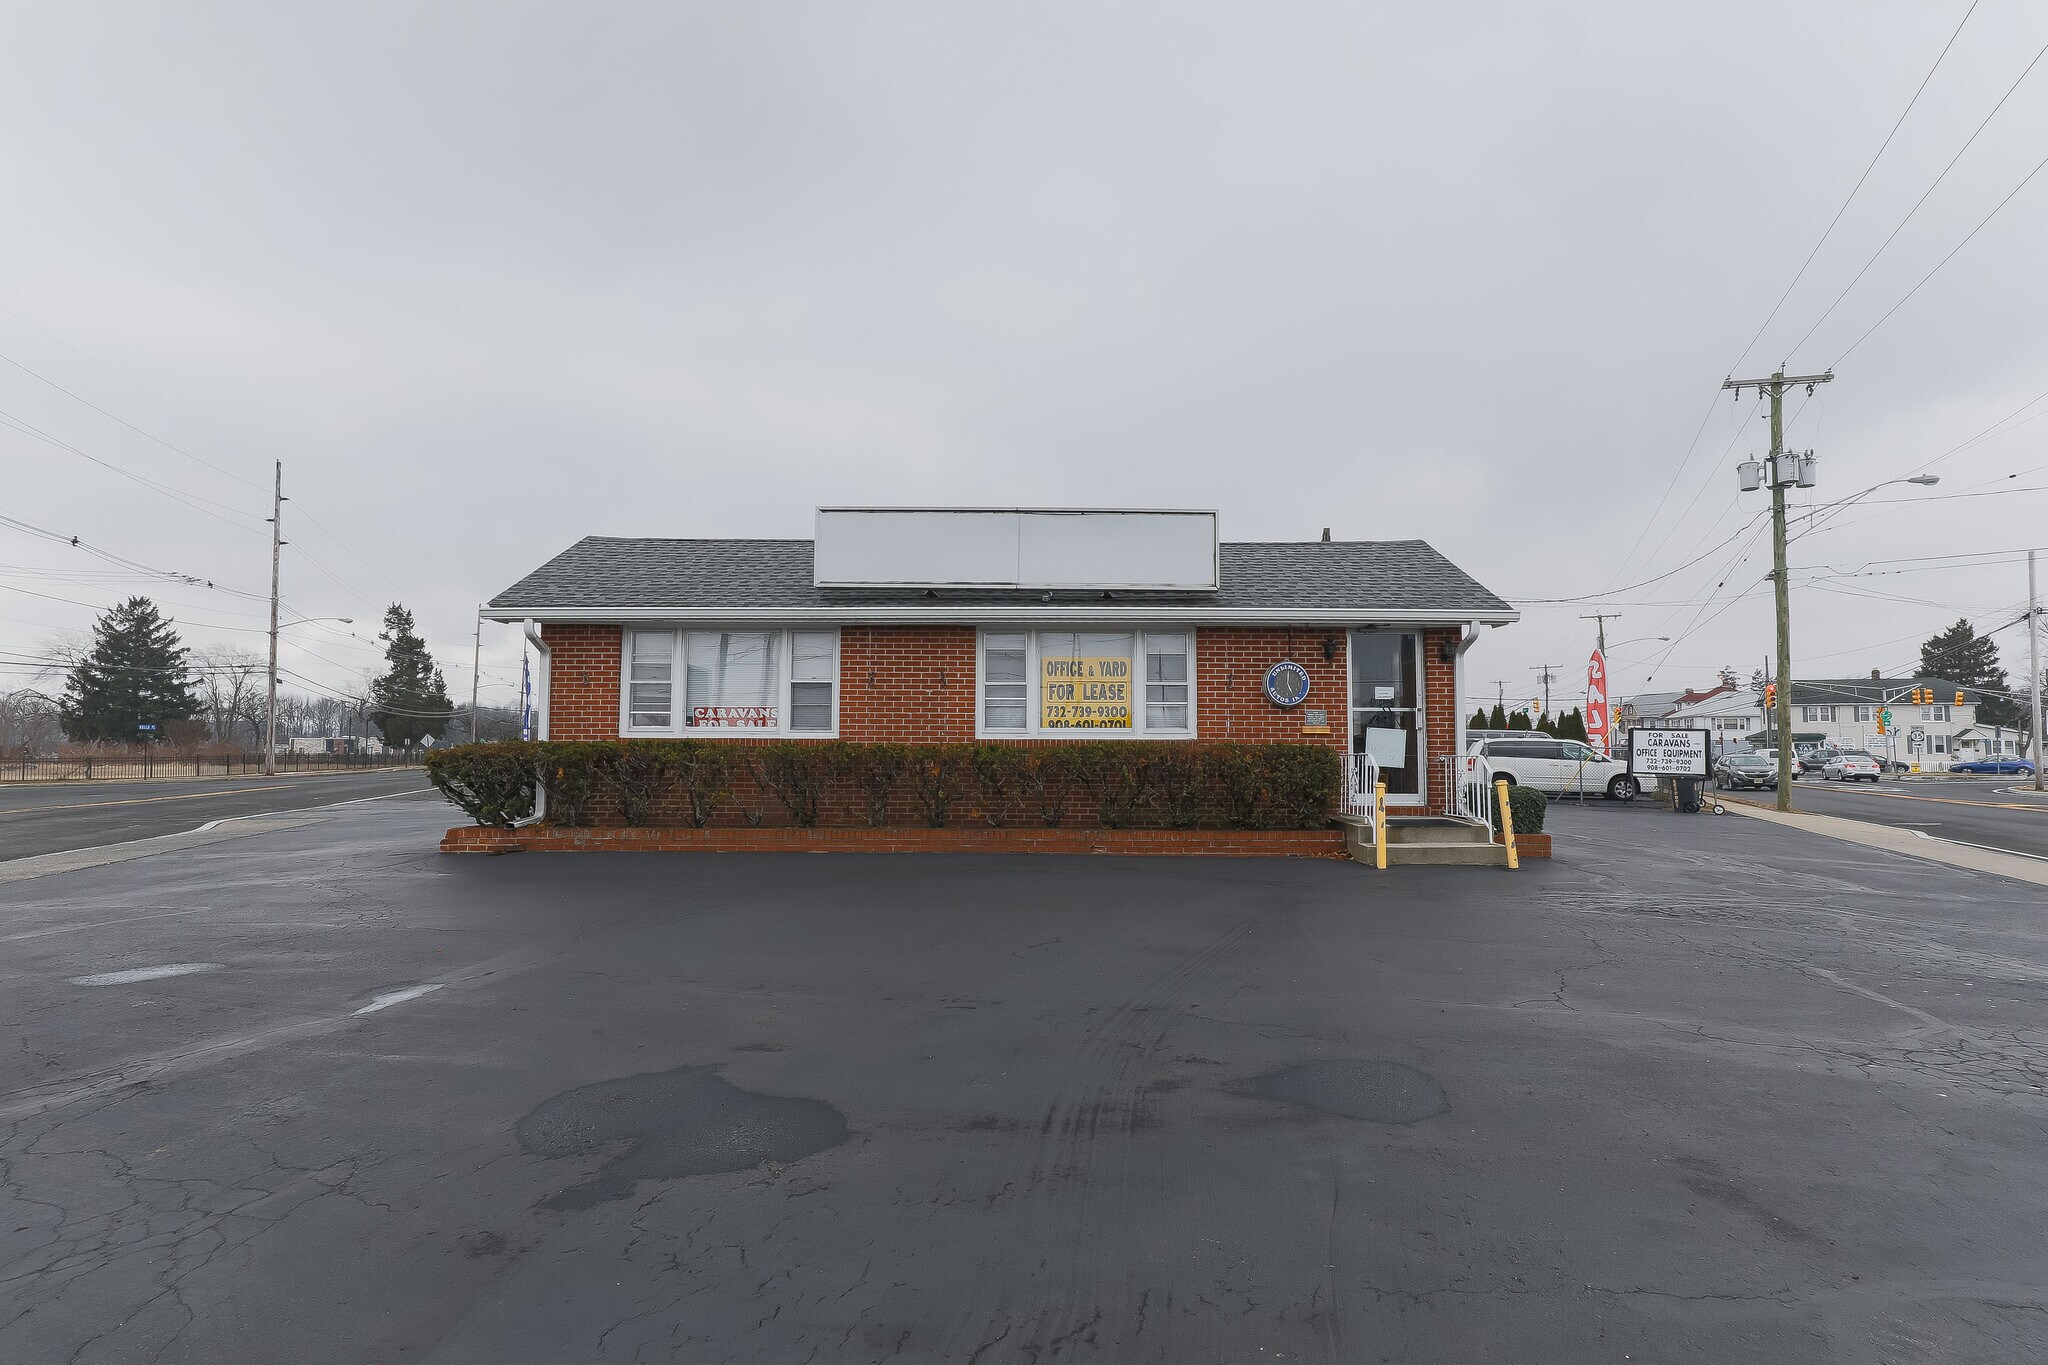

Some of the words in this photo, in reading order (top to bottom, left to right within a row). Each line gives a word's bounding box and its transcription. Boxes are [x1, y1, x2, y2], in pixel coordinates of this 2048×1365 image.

[1047, 661, 1083, 677] OFFICE
[1088, 665, 1095, 677] &
[1099, 661, 1127, 677] YARD
[1271, 664, 1307, 681] UNLIMITED
[1049, 684, 1075, 700] FOR
[1083, 684, 1125, 700] LEASE
[1270, 687, 1290, 703] AUTOS
[694, 708, 779, 719] CARAVANS
[1046, 705, 1127, 718] 732-739-9300
[1647, 738, 1691, 747] CARAVANS
[1636, 748, 1657, 757] OFFICE
[1663, 749, 1702, 758] EQUIPMENT
[1646, 757, 1692, 765] 732-739-9300
[1646, 764, 1691, 772] 908-601-0702
